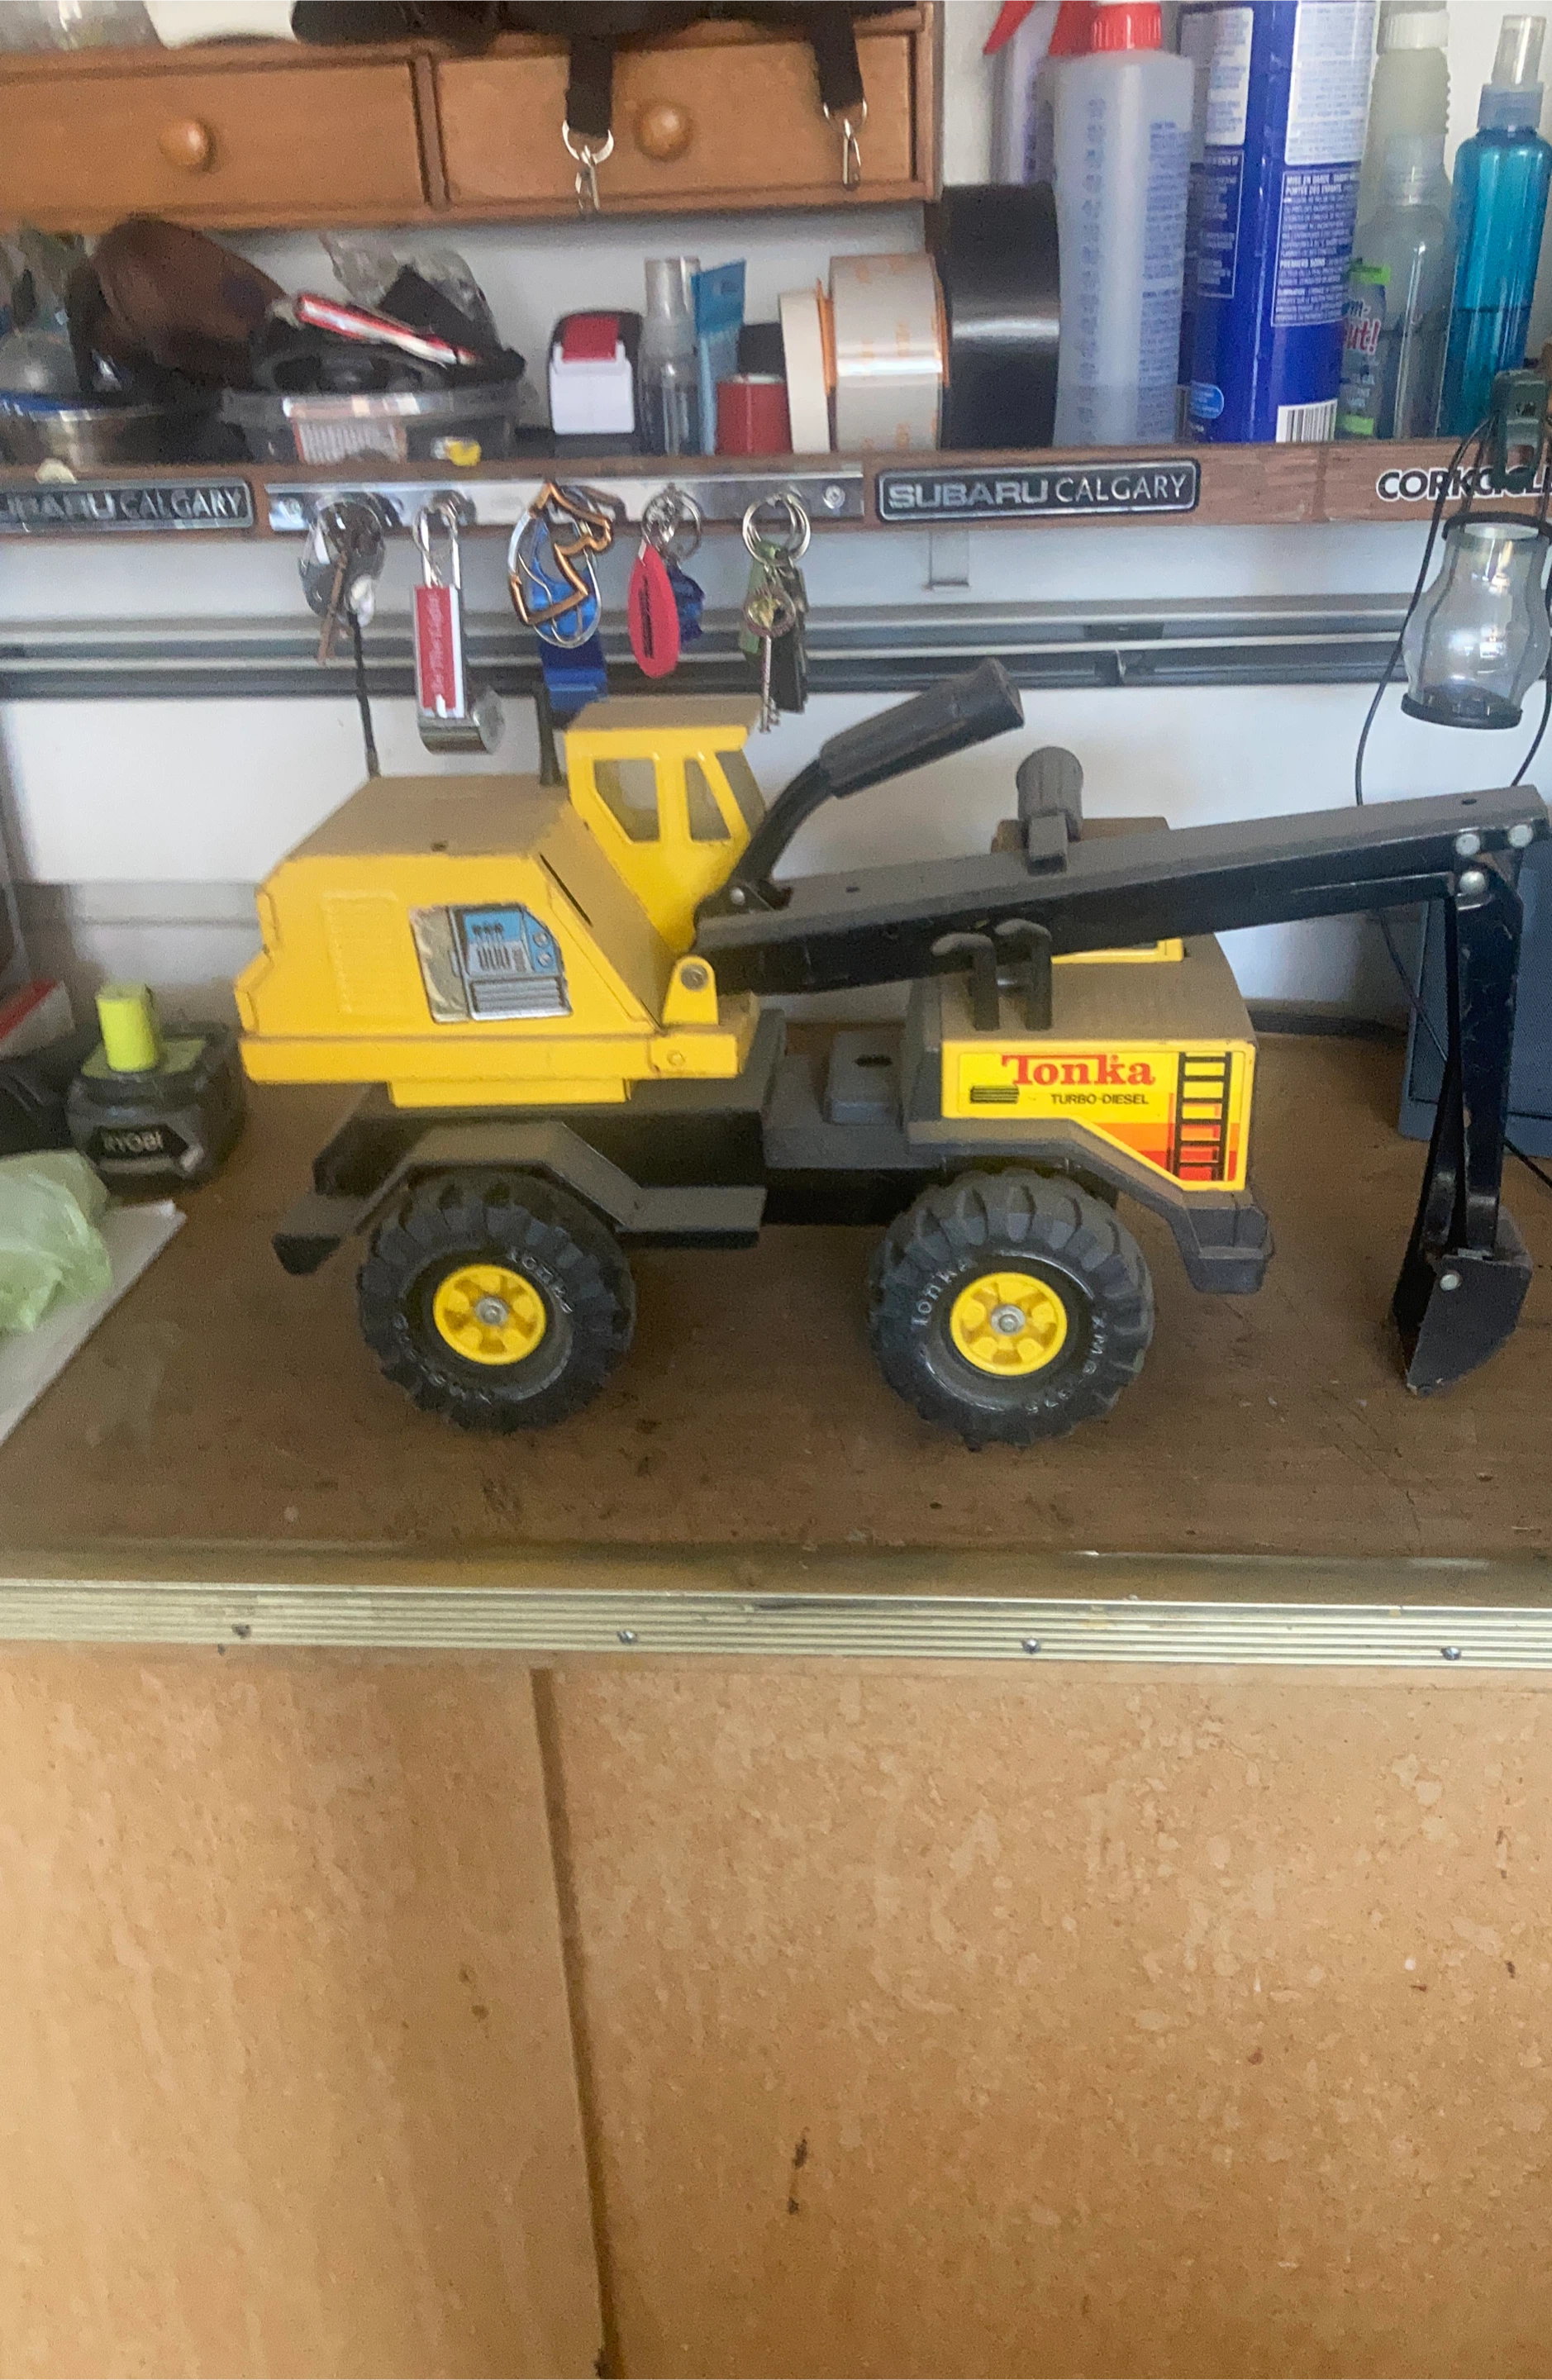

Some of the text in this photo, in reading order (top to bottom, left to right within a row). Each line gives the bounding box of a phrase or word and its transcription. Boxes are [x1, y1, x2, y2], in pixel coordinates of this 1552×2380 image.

[1343, 319, 1381, 355] ut!
[119, 487, 243, 520] CALGARY
[888, 473, 1187, 509] SUBARU CALGARY
[1001, 1054, 1156, 1086] Tonka
